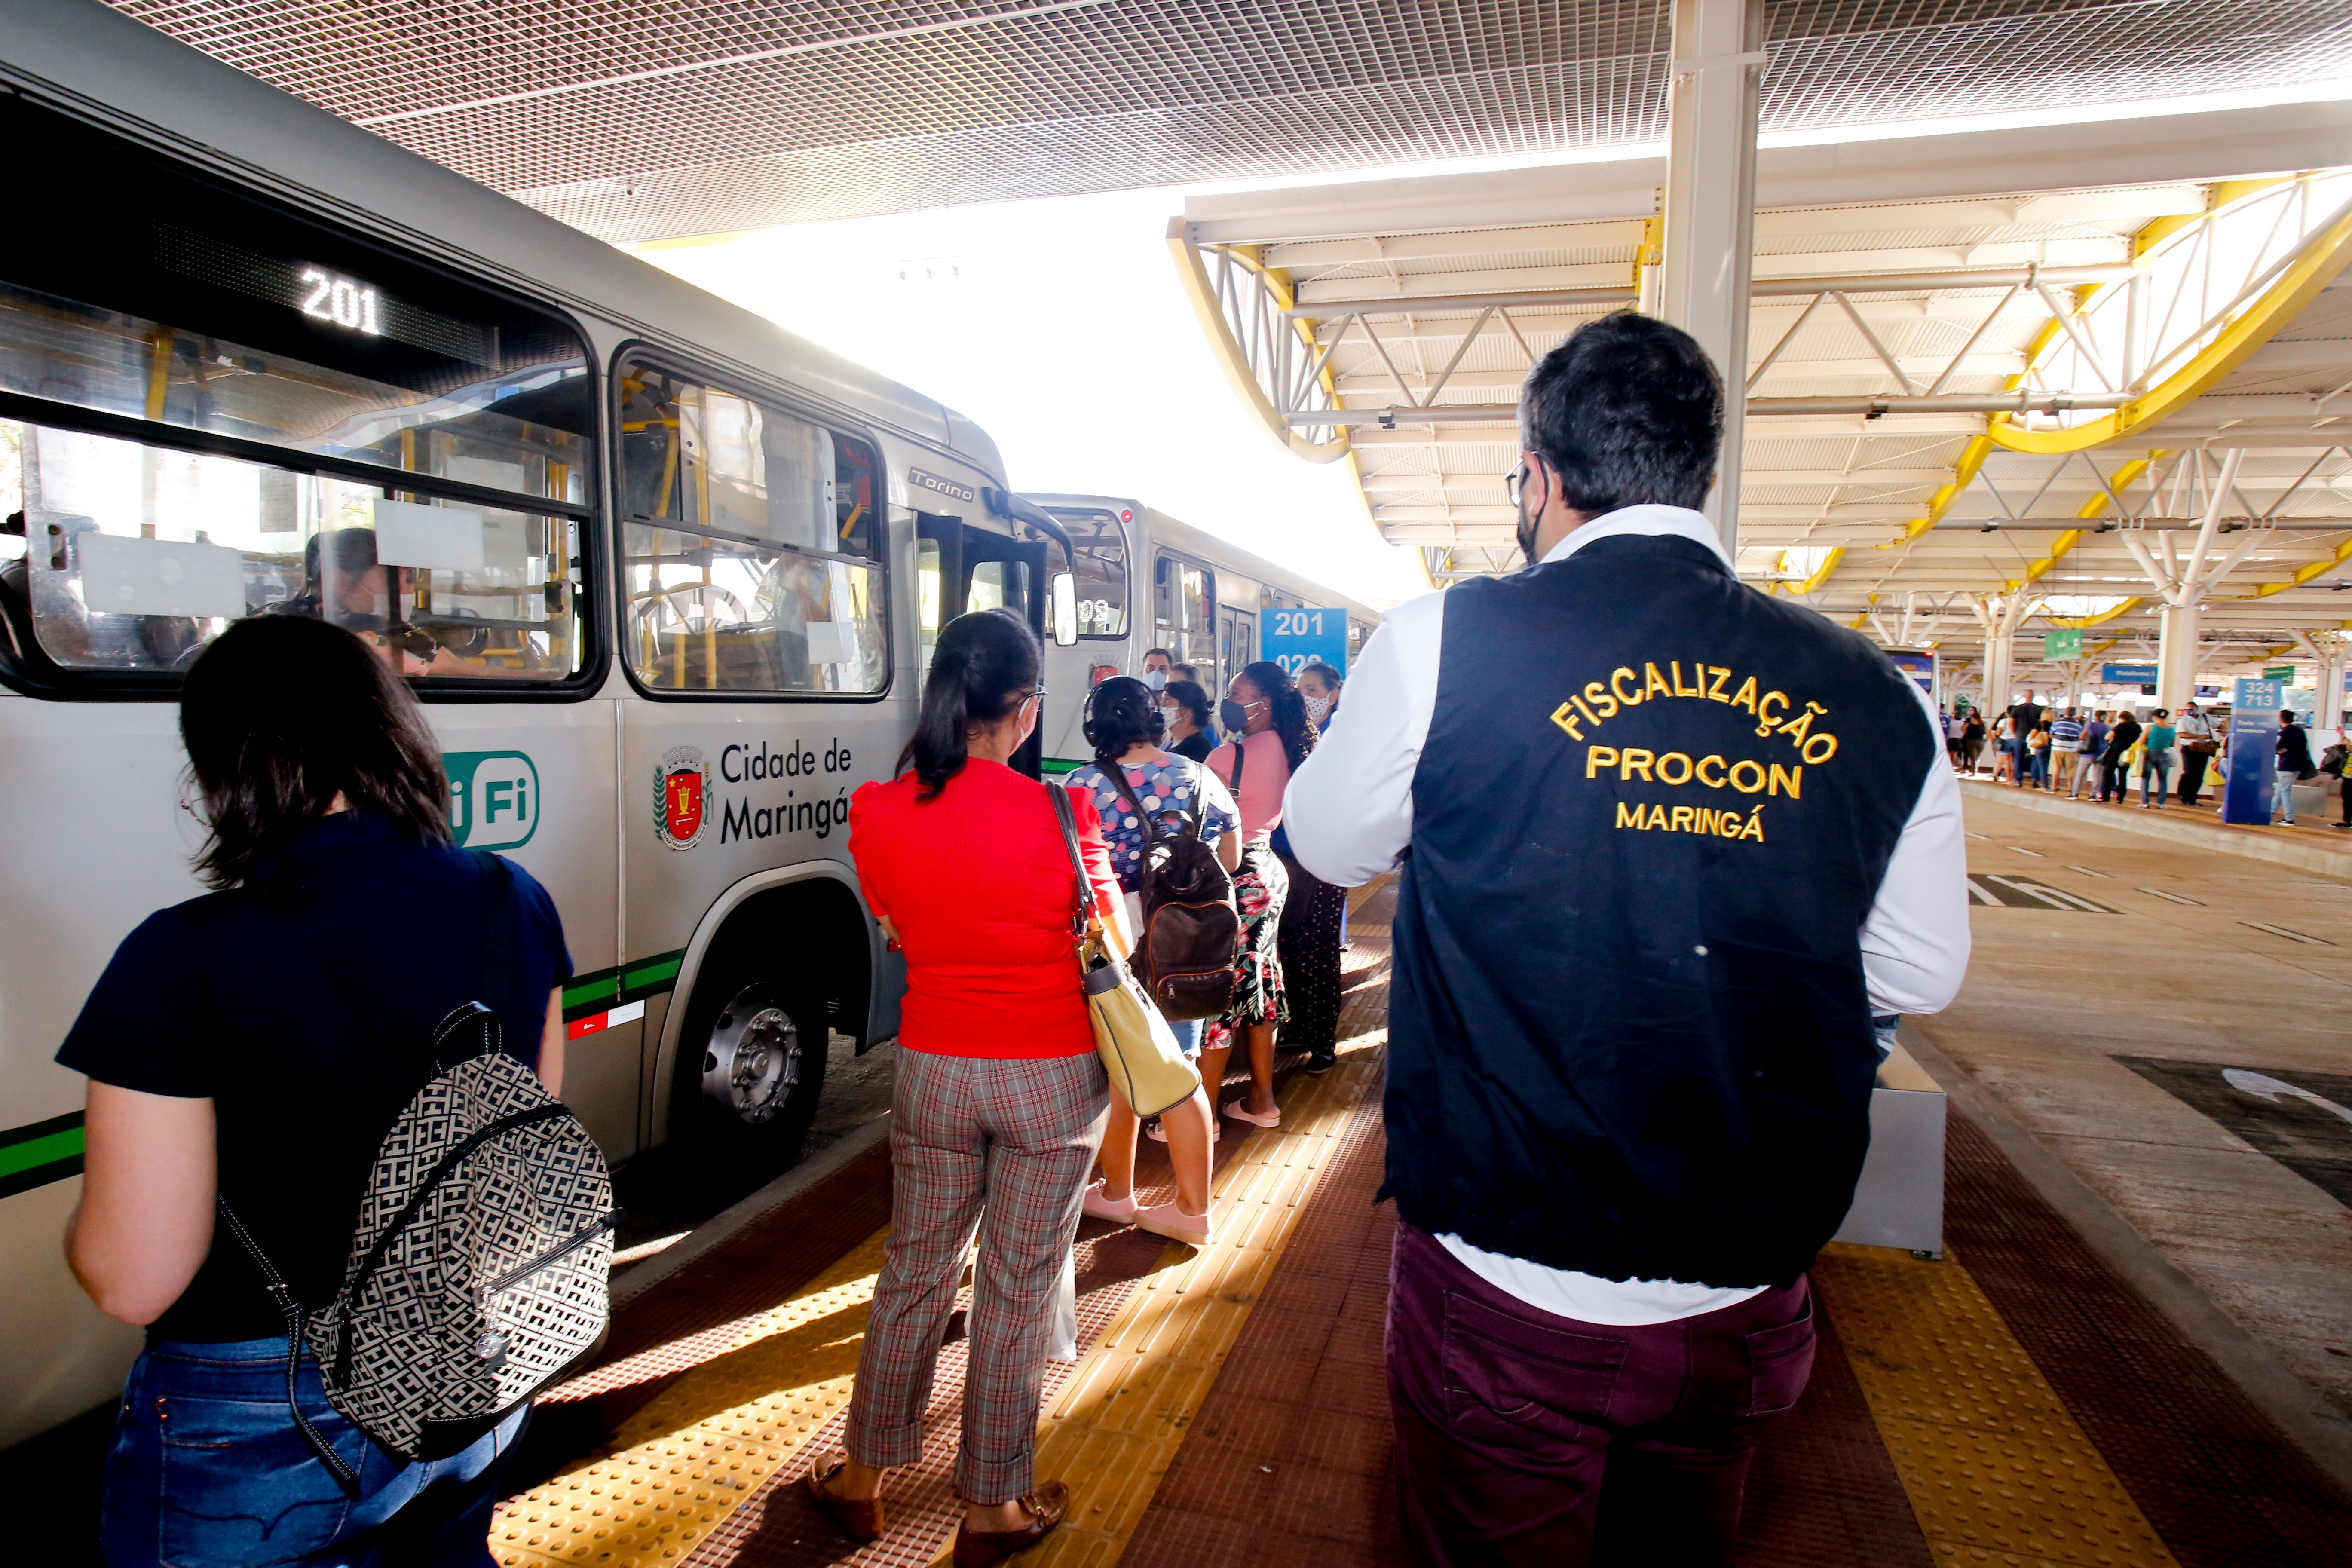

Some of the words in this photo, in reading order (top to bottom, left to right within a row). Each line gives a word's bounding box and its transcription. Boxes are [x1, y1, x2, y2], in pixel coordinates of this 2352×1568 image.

[303, 270, 379, 334] 201
[912, 470, 972, 500] Torino
[1275, 612, 1323, 636] 201
[2245, 682, 2275, 693] 324
[2245, 695, 2274, 707] 713
[1550, 660, 1838, 764] FISCALIZAÇÃO
[721, 741, 815, 783] Cidade
[824, 737, 851, 773] de
[1586, 745, 1802, 799] PROCON
[720, 787, 848, 844] Maringá
[1615, 802, 1765, 842] MARINGÁ
